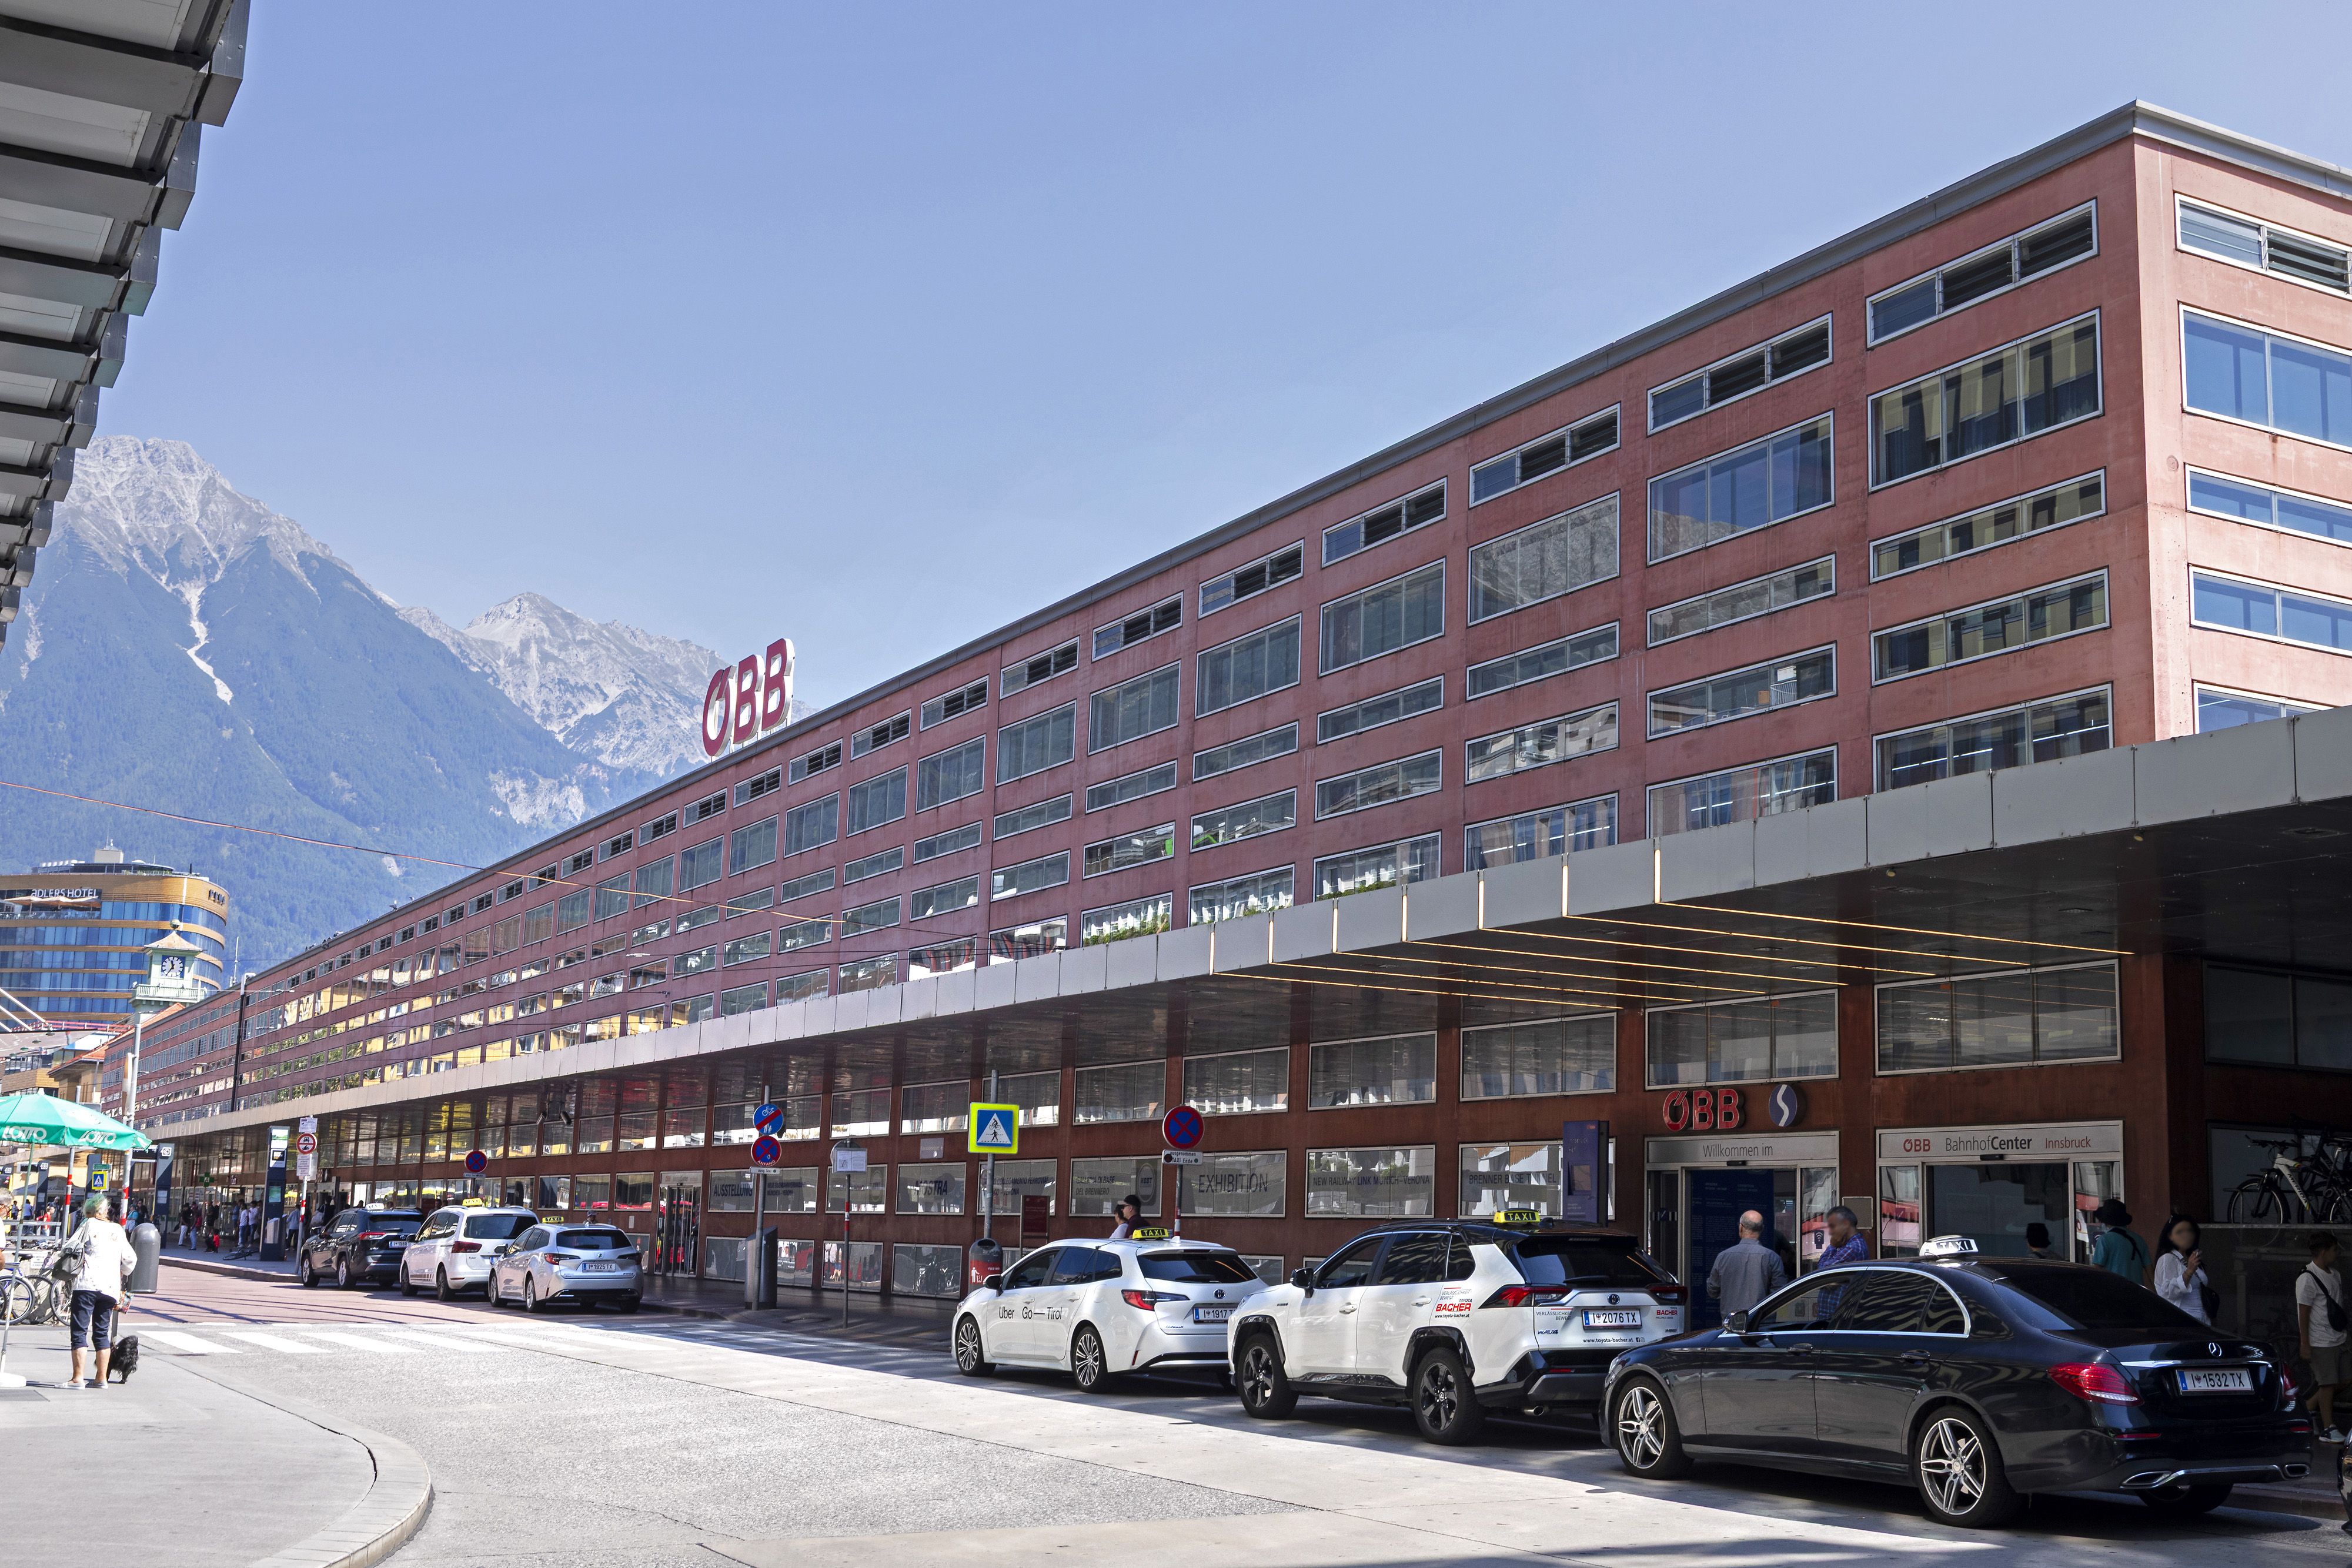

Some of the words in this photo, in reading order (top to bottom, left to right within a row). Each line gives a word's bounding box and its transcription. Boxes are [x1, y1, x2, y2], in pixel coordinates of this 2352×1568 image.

[703, 638, 791, 756] ÖBB
[67, 889, 99, 898] HOTEL
[1663, 1089, 1739, 1131] ÖBB
[2, 1125, 47, 1140] LOTTO
[78, 1129, 116, 1144] LOTTO
[1703, 1144, 1759, 1158] Willkommen
[1762, 1143, 1773, 1156] im
[1903, 1139, 1931, 1152] ÖBB
[1946, 1135, 2032, 1152] BahnhofCenter
[2045, 1136, 2092, 1149] Innsbruck
[1198, 1173, 1268, 1193] EXHIBITION
[1313, 1176, 1327, 1186] NEW
[1329, 1176, 1355, 1185] RAILWAY
[1358, 1176, 1372, 1185] LINK
[1469, 1174, 1502, 1184] BRENNER
[1505, 1174, 1524, 1183] BASE
[713, 1183, 753, 1196] AUSSTELLUNG
[2288, 1173, 2307, 1203] MERIDA
[1940, 1241, 1969, 1251] TAXI
[999, 1306, 1014, 1319] Uber
[1212, 1310, 1227, 1318] 1917
[1229, 1309, 1235, 1318] T
[1435, 1303, 1472, 1312] BACHER
[1602, 1312, 1624, 1323] 2076
[1625, 1312, 1636, 1323] TX
[2191, 1373, 2196, 1388] I
[2203, 1373, 2229, 1388] 1532
[2229, 1373, 2244, 1387] TX
